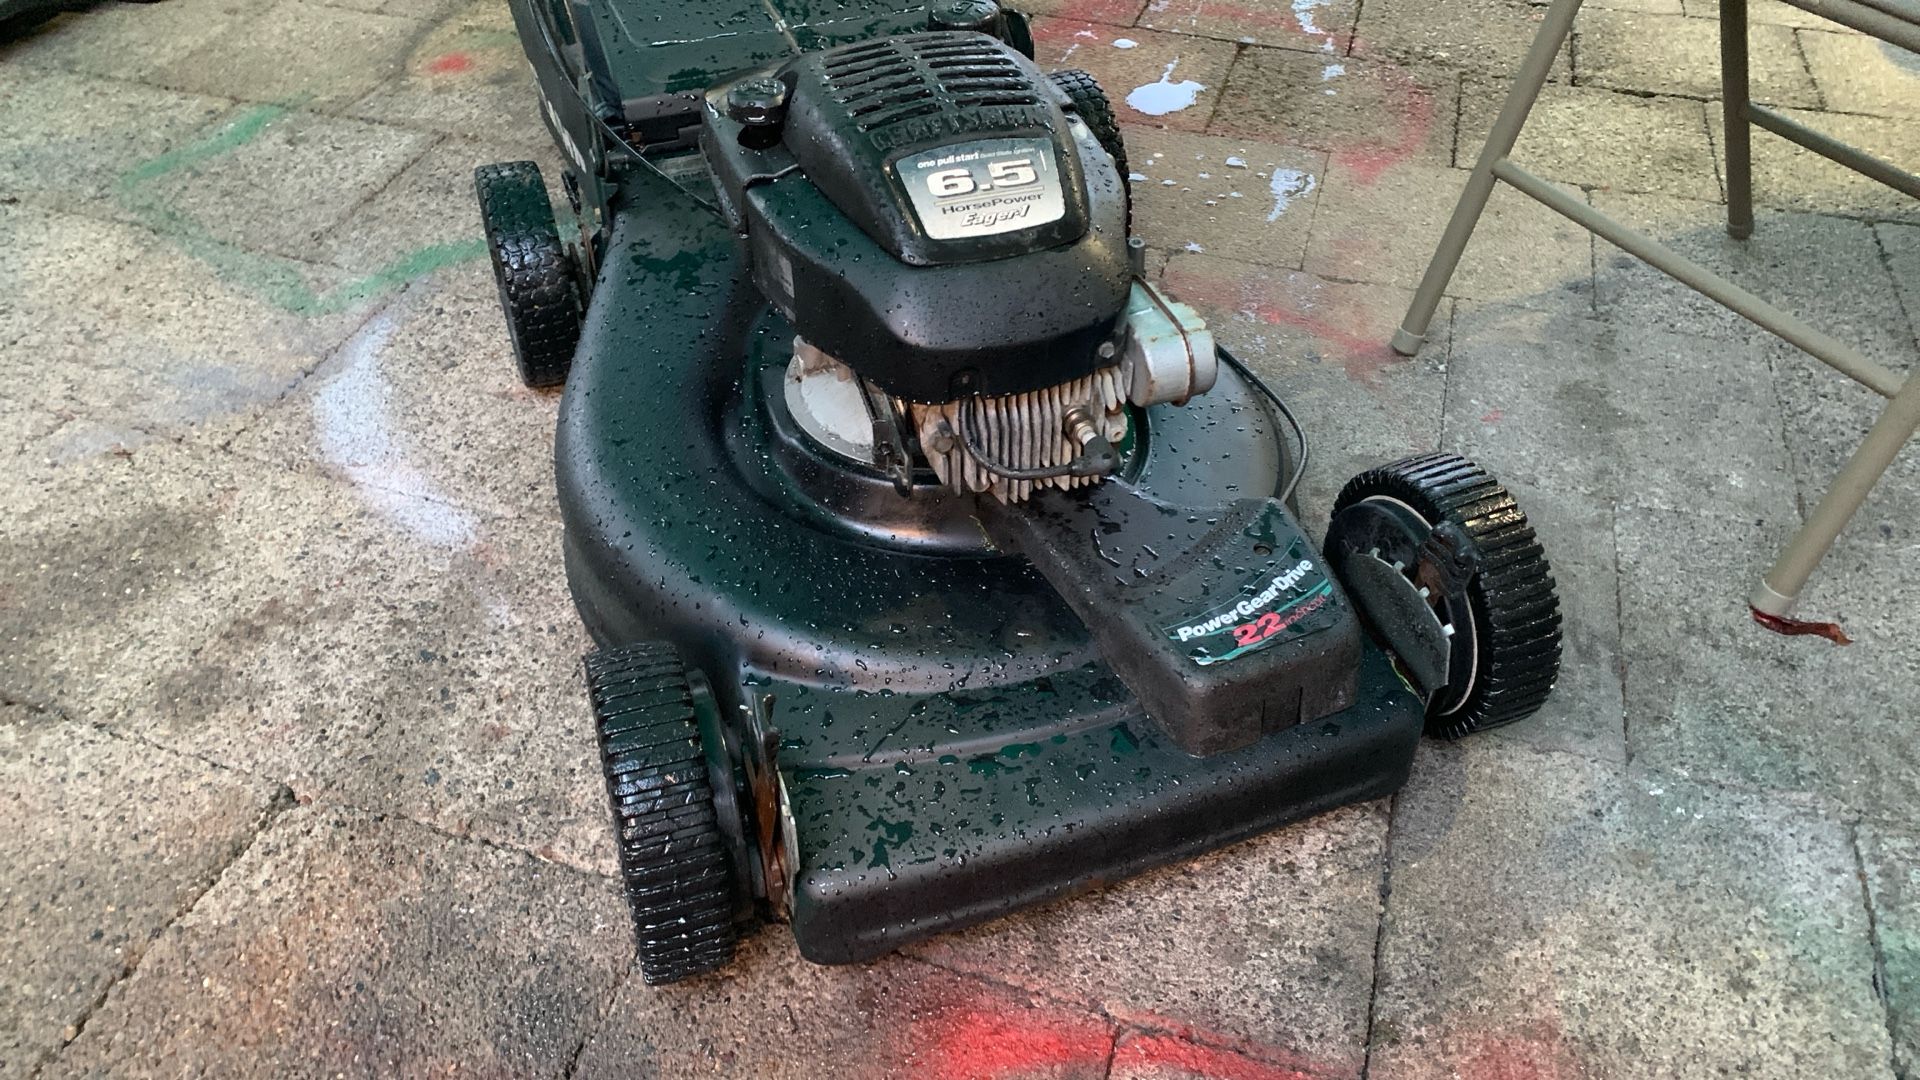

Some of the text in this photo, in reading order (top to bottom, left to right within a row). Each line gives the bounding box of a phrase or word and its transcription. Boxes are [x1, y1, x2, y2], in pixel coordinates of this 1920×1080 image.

[917, 160, 936, 169] one
[937, 155, 955, 167] pull
[955, 151, 979, 162] start
[927, 159, 1039, 198] 6.5
[942, 192, 1044, 215] HorsePower
[1232, 611, 1287, 647] 22
